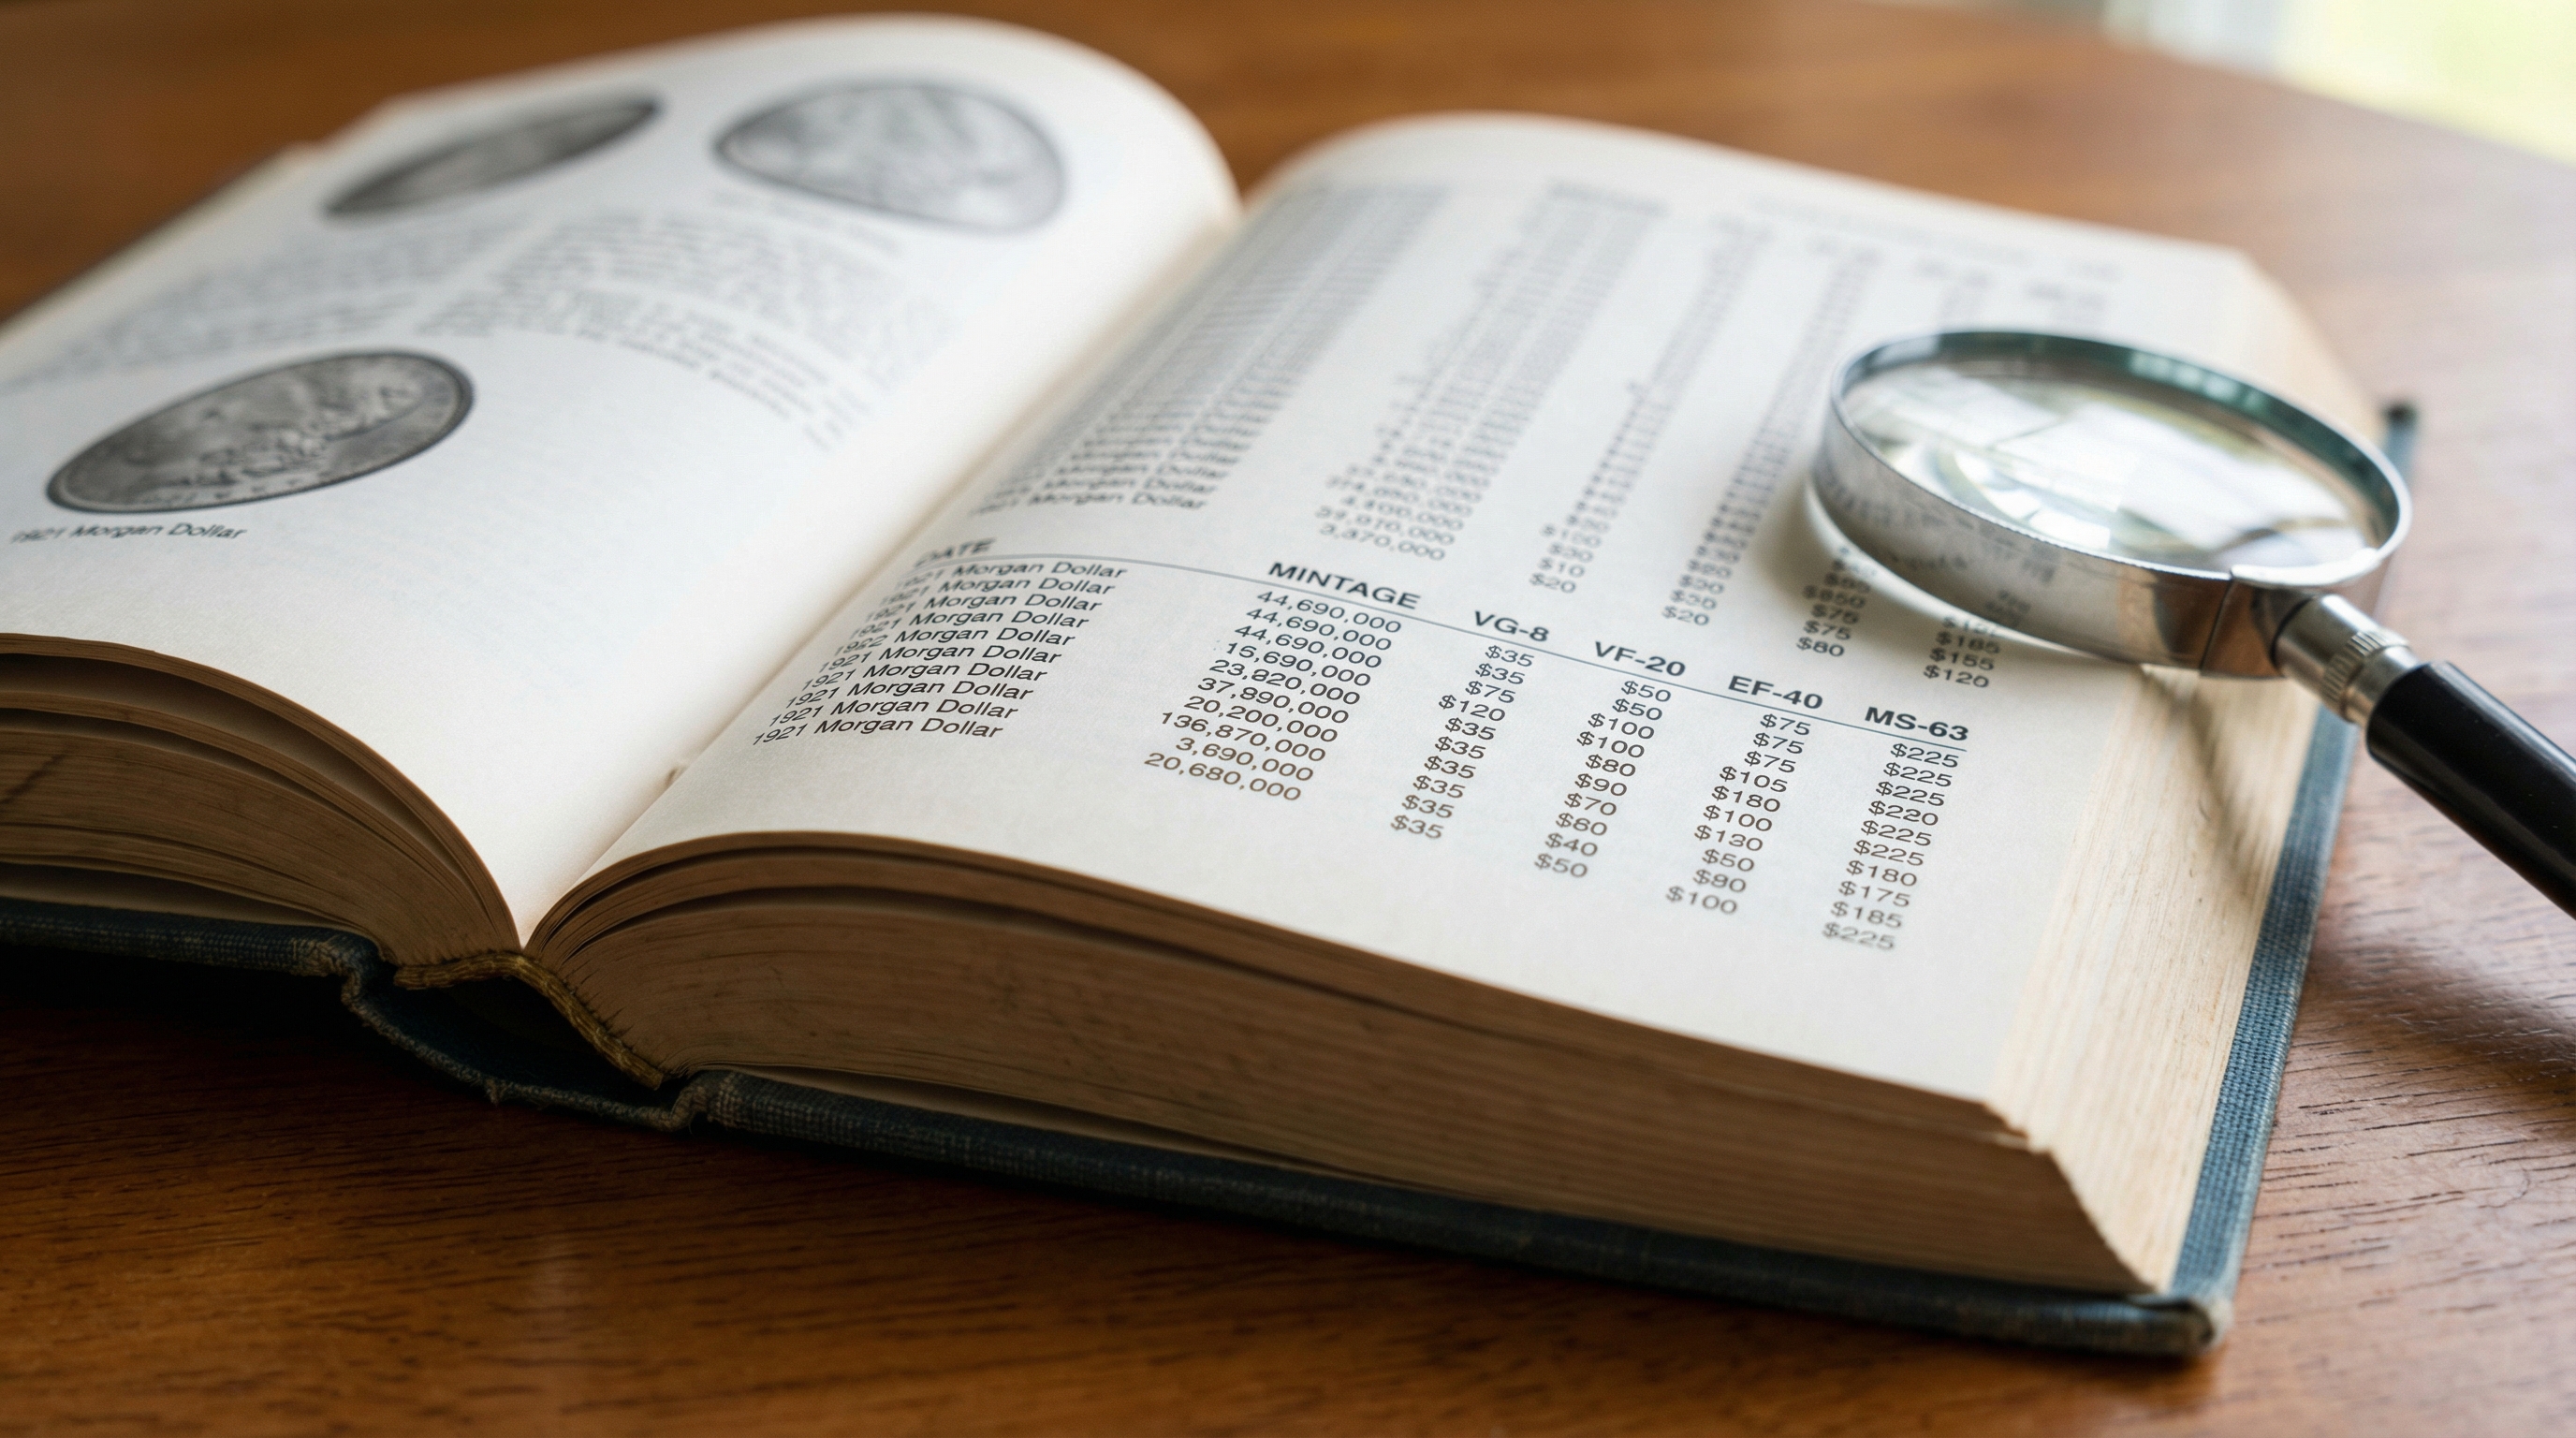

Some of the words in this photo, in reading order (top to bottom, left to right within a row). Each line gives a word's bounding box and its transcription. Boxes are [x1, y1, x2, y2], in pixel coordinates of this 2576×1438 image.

[70, 524, 164, 539] Morgan
[168, 522, 247, 539] Dollar
[1529, 572, 1576, 594] $20
[1661, 606, 1710, 626] $20
[1796, 637, 1845, 657] $80
[1924, 664, 1989, 688] $120
[1804, 620, 1851, 641] $75
[819, 651, 871, 673] 1921
[878, 645, 975, 662] Morgan
[982, 645, 1062, 664] Dollar
[1197, 677, 1349, 724] 37,890,000
[1434, 736, 1486, 759] $35
[1574, 773, 1627, 797] $90
[1703, 804, 1773, 831] $100
[1853, 840, 1925, 866] $225
[894, 628, 988, 643] Morgan
[996, 627, 1076, 646] Dollar
[1444, 717, 1496, 740] $35
[1585, 754, 1636, 777] $80
[1711, 785, 1780, 812] $180
[1861, 820, 1932, 846] $225
[909, 610, 1003, 625] Morgan
[1011, 610, 1090, 628] Dollar
[1226, 642, 1371, 686] 15,690,000
[1439, 695, 1505, 722] $120
[1576, 731, 1645, 758] $100
[1720, 766, 1788, 793] $105
[1868, 800, 1939, 826] $220
[923, 594, 1017, 609] Morgan
[1024, 594, 1103, 611] Dollar
[1235, 625, 1382, 668] 44,690,000
[1465, 681, 1515, 703] $75
[1588, 712, 1655, 739] $100
[1744, 751, 1796, 773] $75
[1876, 781, 1945, 806] $225
[937, 578, 1032, 593] Morgan
[1038, 578, 1115, 594] Dollar
[1246, 609, 1392, 650] 44,690,000
[1475, 663, 1525, 684] $35
[1612, 698, 1662, 720] $50
[1753, 732, 1805, 755] $75
[1883, 762, 1953, 787] $225
[951, 563, 1044, 578] Morgan
[1051, 561, 1127, 578] Dollar
[1257, 591, 1401, 633] 44,690,000
[1485, 645, 1534, 667] $35
[1621, 681, 1671, 702] $50
[1760, 713, 1811, 736] $75
[1890, 743, 1959, 768] $225
[1267, 562, 1421, 609] MINTAGE
[1474, 610, 1549, 642] VG-8
[1595, 641, 1686, 676] VF-20
[1728, 675, 1823, 709] EF-40
[1865, 706, 1969, 741] MS-63
[753, 724, 808, 745] 1921
[813, 718, 914, 734] Morgan
[920, 717, 1003, 738] Dollar
[1144, 753, 1301, 800] 20,680,000
[1390, 814, 1444, 839] $35
[1534, 853, 1588, 878] $50
[1665, 885, 1737, 915] $100
[1822, 921, 1895, 951] $225
[768, 706, 824, 727] 1921
[829, 699, 929, 715] Morgan
[936, 698, 1018, 719] Dollar
[1176, 737, 1314, 781] 3,690,000
[1401, 794, 1455, 818] $35
[1544, 832, 1598, 857] $40
[1830, 901, 1903, 929] $185
[785, 686, 841, 709] 1921
[846, 681, 945, 697] Morgan
[952, 681, 1033, 700] Dollar
[1162, 712, 1325, 761] 136,870,000
[1412, 775, 1466, 799] $35
[1837, 880, 1910, 907] $175
[801, 668, 856, 691] 1921
[862, 663, 960, 679] Morgan
[967, 662, 1047, 682] Dollar
[1183, 696, 1339, 742] 20,200,000
[1424, 756, 1476, 779] $35
[1564, 792, 1617, 815] $70
[1693, 825, 1764, 851] $130
[1846, 859, 1917, 887] $180
